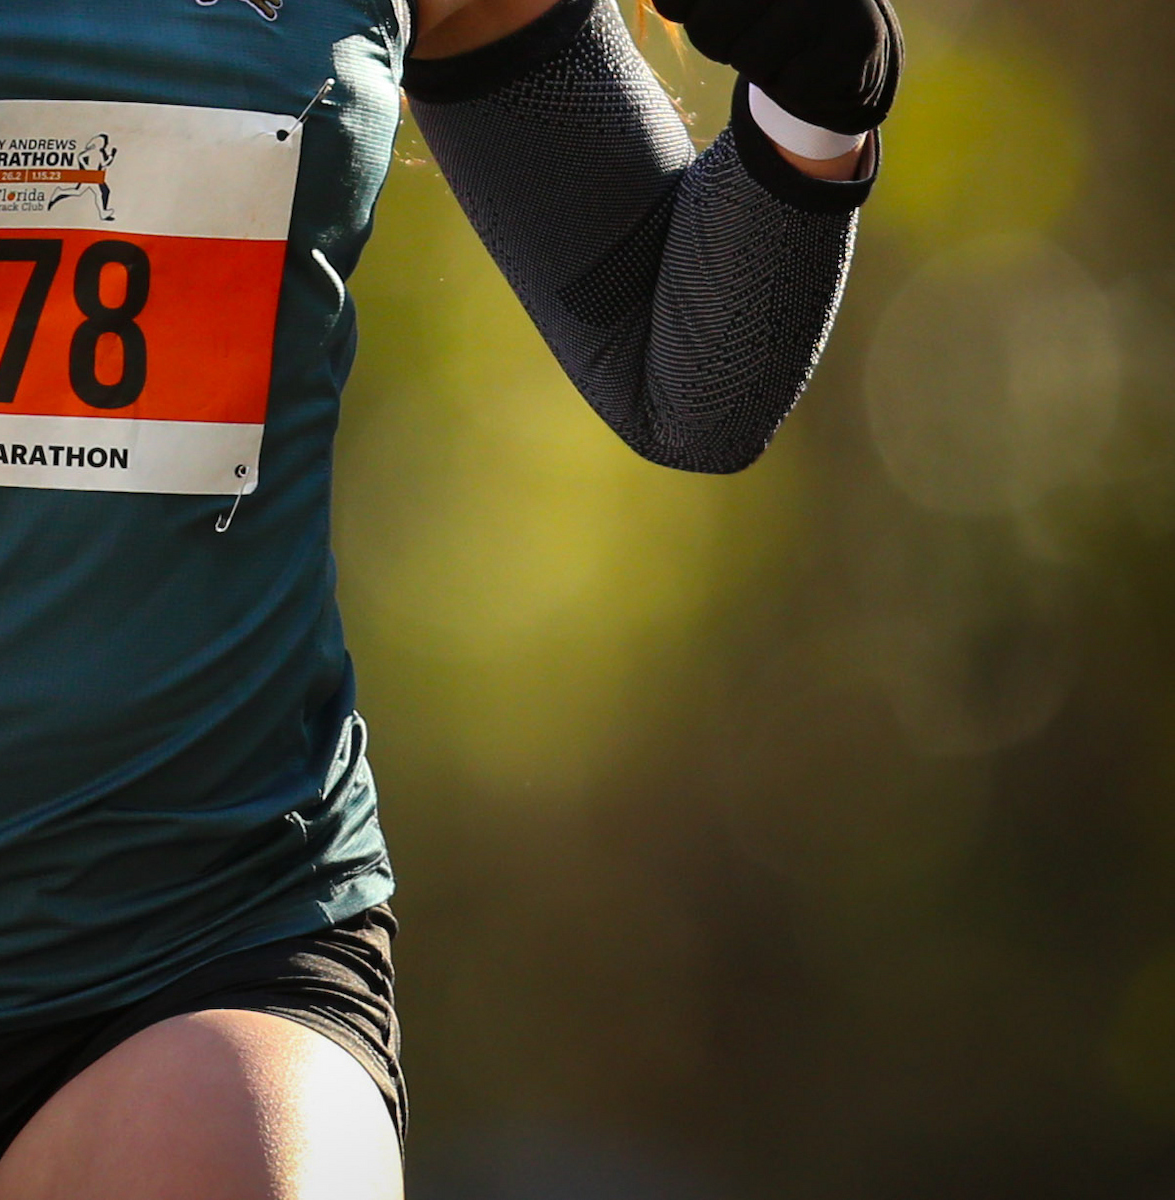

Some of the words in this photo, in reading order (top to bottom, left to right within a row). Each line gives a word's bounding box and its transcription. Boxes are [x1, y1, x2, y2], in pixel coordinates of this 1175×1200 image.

[9, 140, 76, 150] ANDREWS
[1, 172, 22, 181] 26.2
[21, 202, 44, 211] Club
